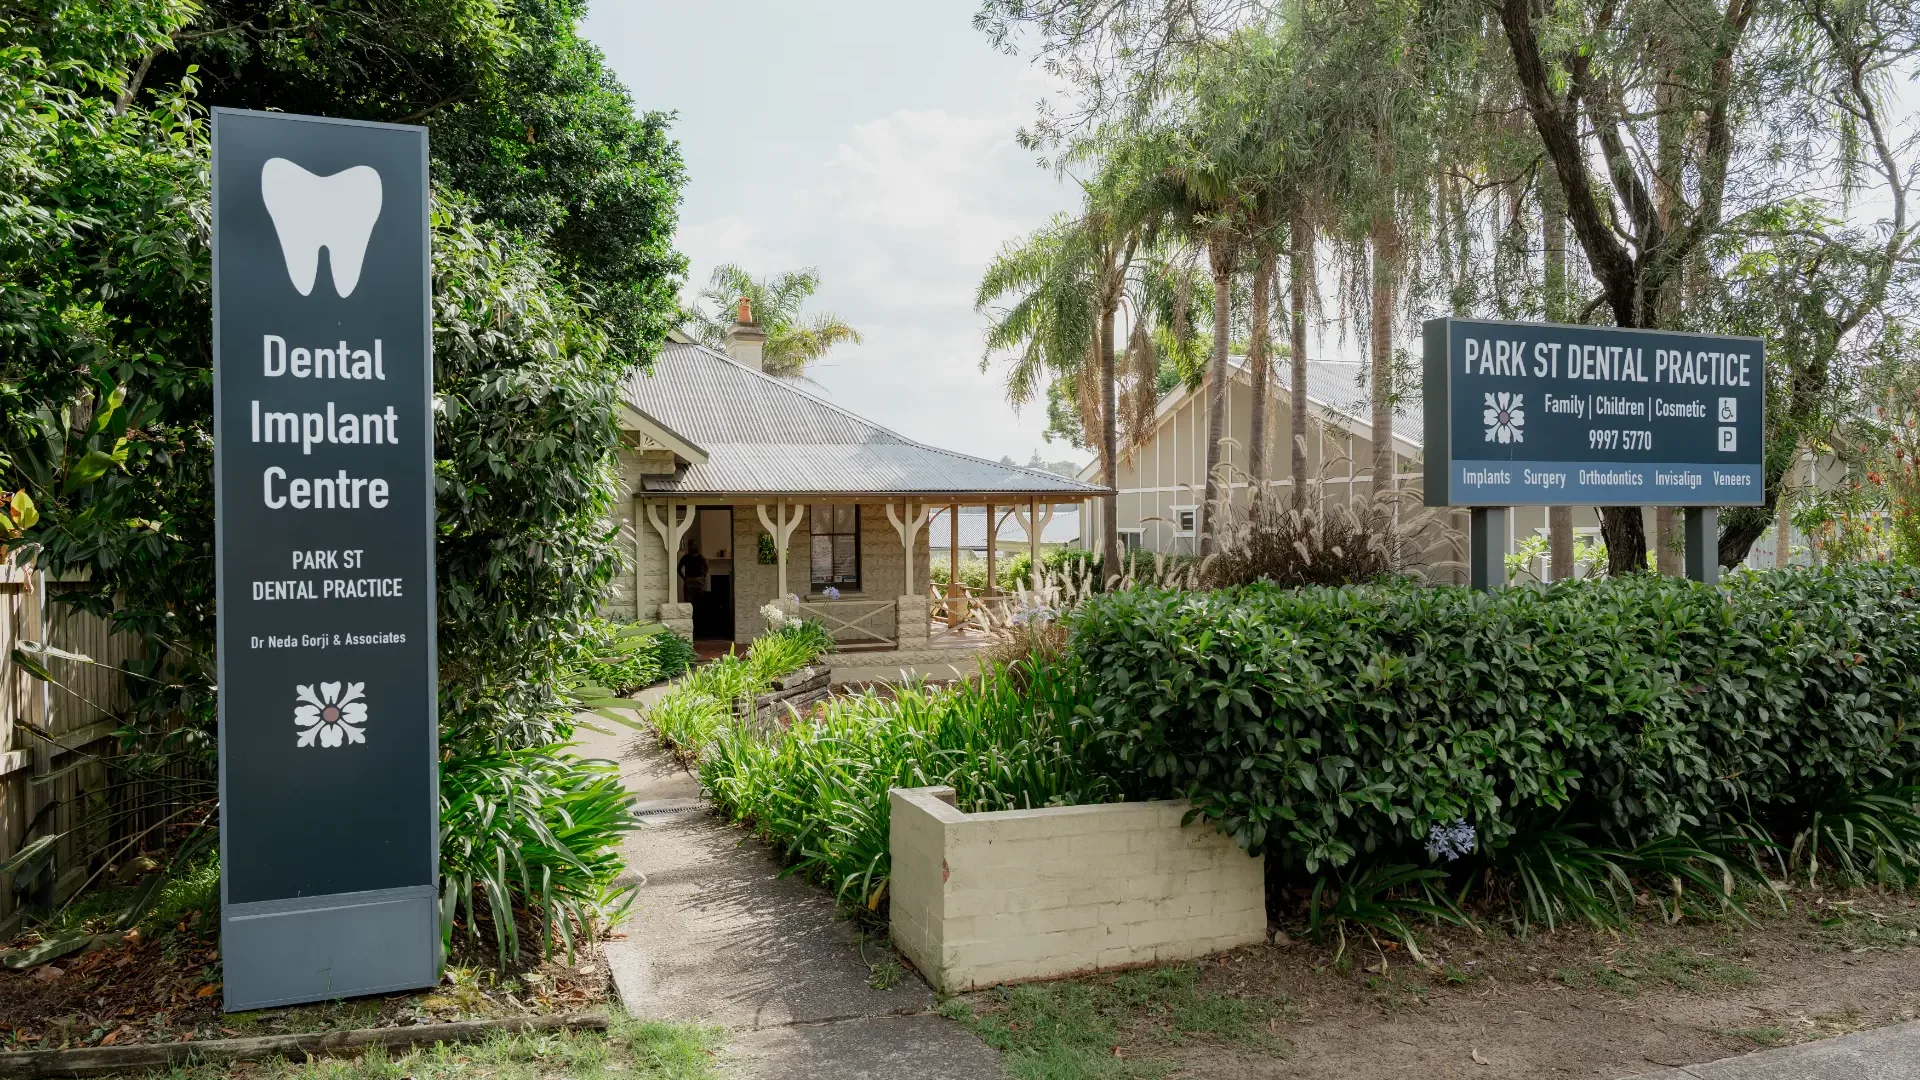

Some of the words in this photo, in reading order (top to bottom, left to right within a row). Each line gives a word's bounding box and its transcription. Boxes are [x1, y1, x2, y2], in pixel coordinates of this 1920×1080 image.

[263, 334, 386, 381] Dental
[1465, 338, 1527, 377] PARK
[1533, 342, 1562, 378] ST
[1567, 343, 1649, 383] DENTAL
[1655, 349, 1751, 387] PRACTICE
[1544, 393, 1585, 419] Family
[1596, 395, 1645, 416] Children
[1655, 398, 1707, 418] Cosmetic
[251, 400, 399, 455] Implant
[1723, 430, 1733, 449] P
[1588, 429, 1619, 450] 9997
[1622, 430, 1652, 451] 5770
[263, 466, 389, 510] Centre
[1463, 467, 1511, 489] Implants
[1523, 468, 1567, 489] Surgery
[1579, 469, 1643, 486] Orthodontics
[1655, 469, 1702, 490] Invisalign
[1713, 470, 1751, 486] Veneers
[292, 549, 339, 570] PARK
[343, 549, 364, 569] ST
[252, 579, 319, 601] DENTAL
[323, 577, 403, 599] PRACTICE
[251, 636, 265, 649] Dr
[268, 634, 298, 648] Neda
[301, 633, 329, 650] Gorji
[332, 634, 342, 646] &
[344, 631, 406, 646] Associates
